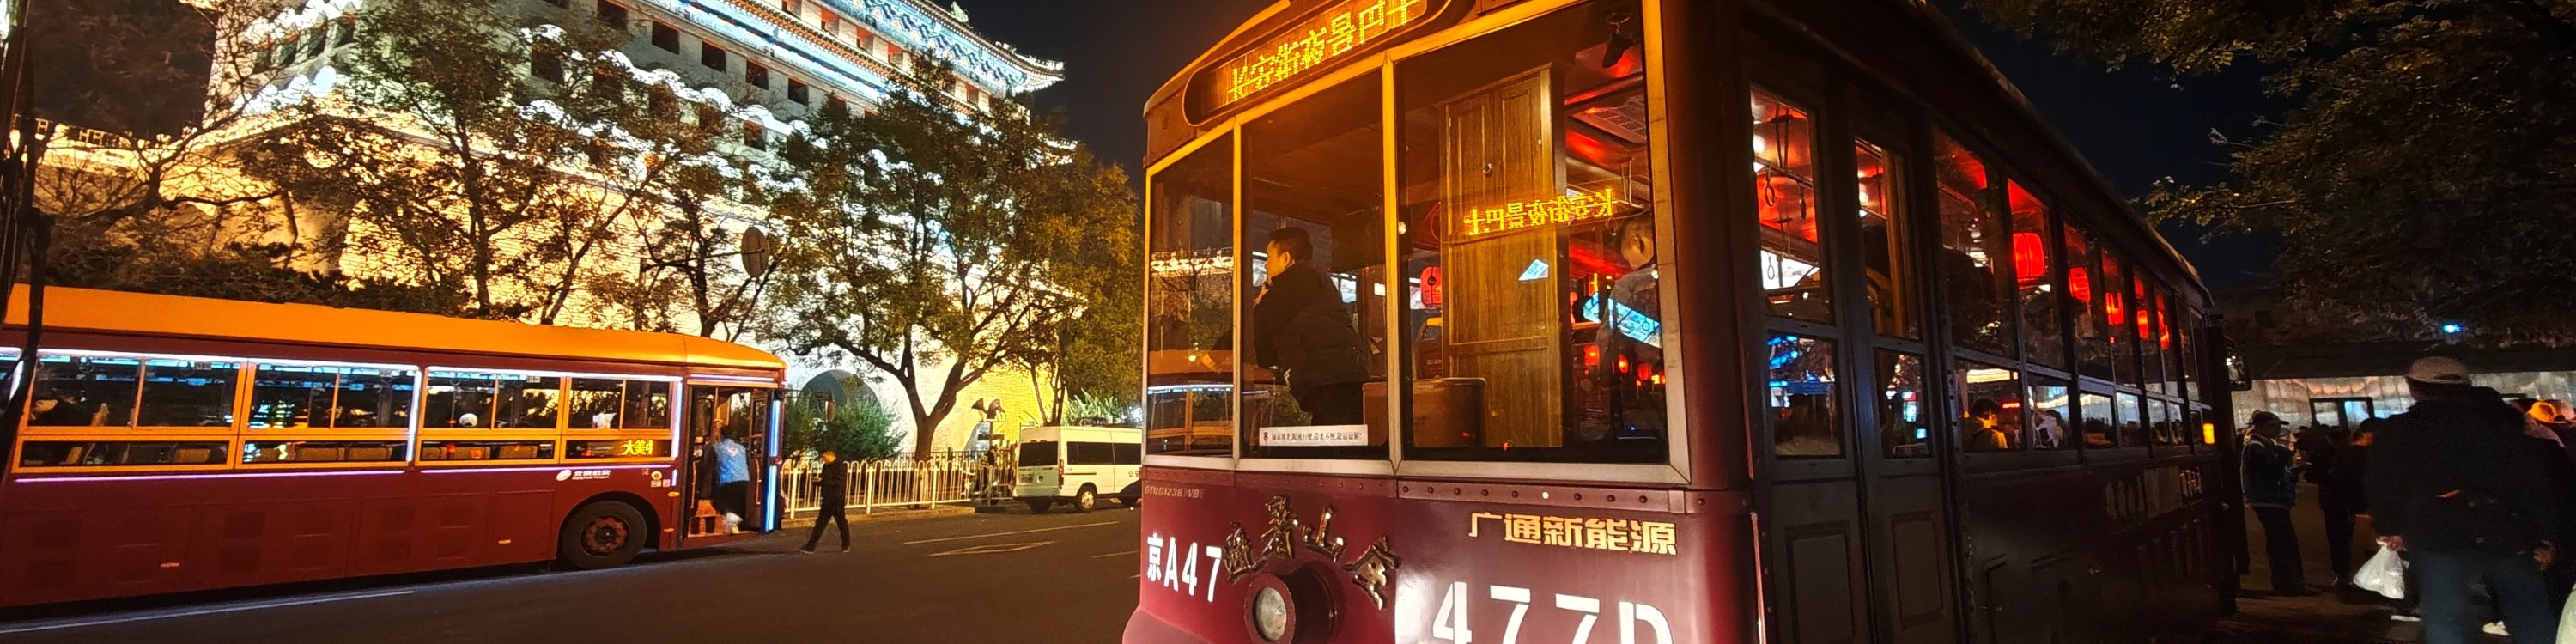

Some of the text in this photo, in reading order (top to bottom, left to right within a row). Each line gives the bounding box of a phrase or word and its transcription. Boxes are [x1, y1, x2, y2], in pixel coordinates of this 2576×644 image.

[1467, 511, 1678, 556] 广通新能源
[1146, 532, 1223, 603] 京A47
